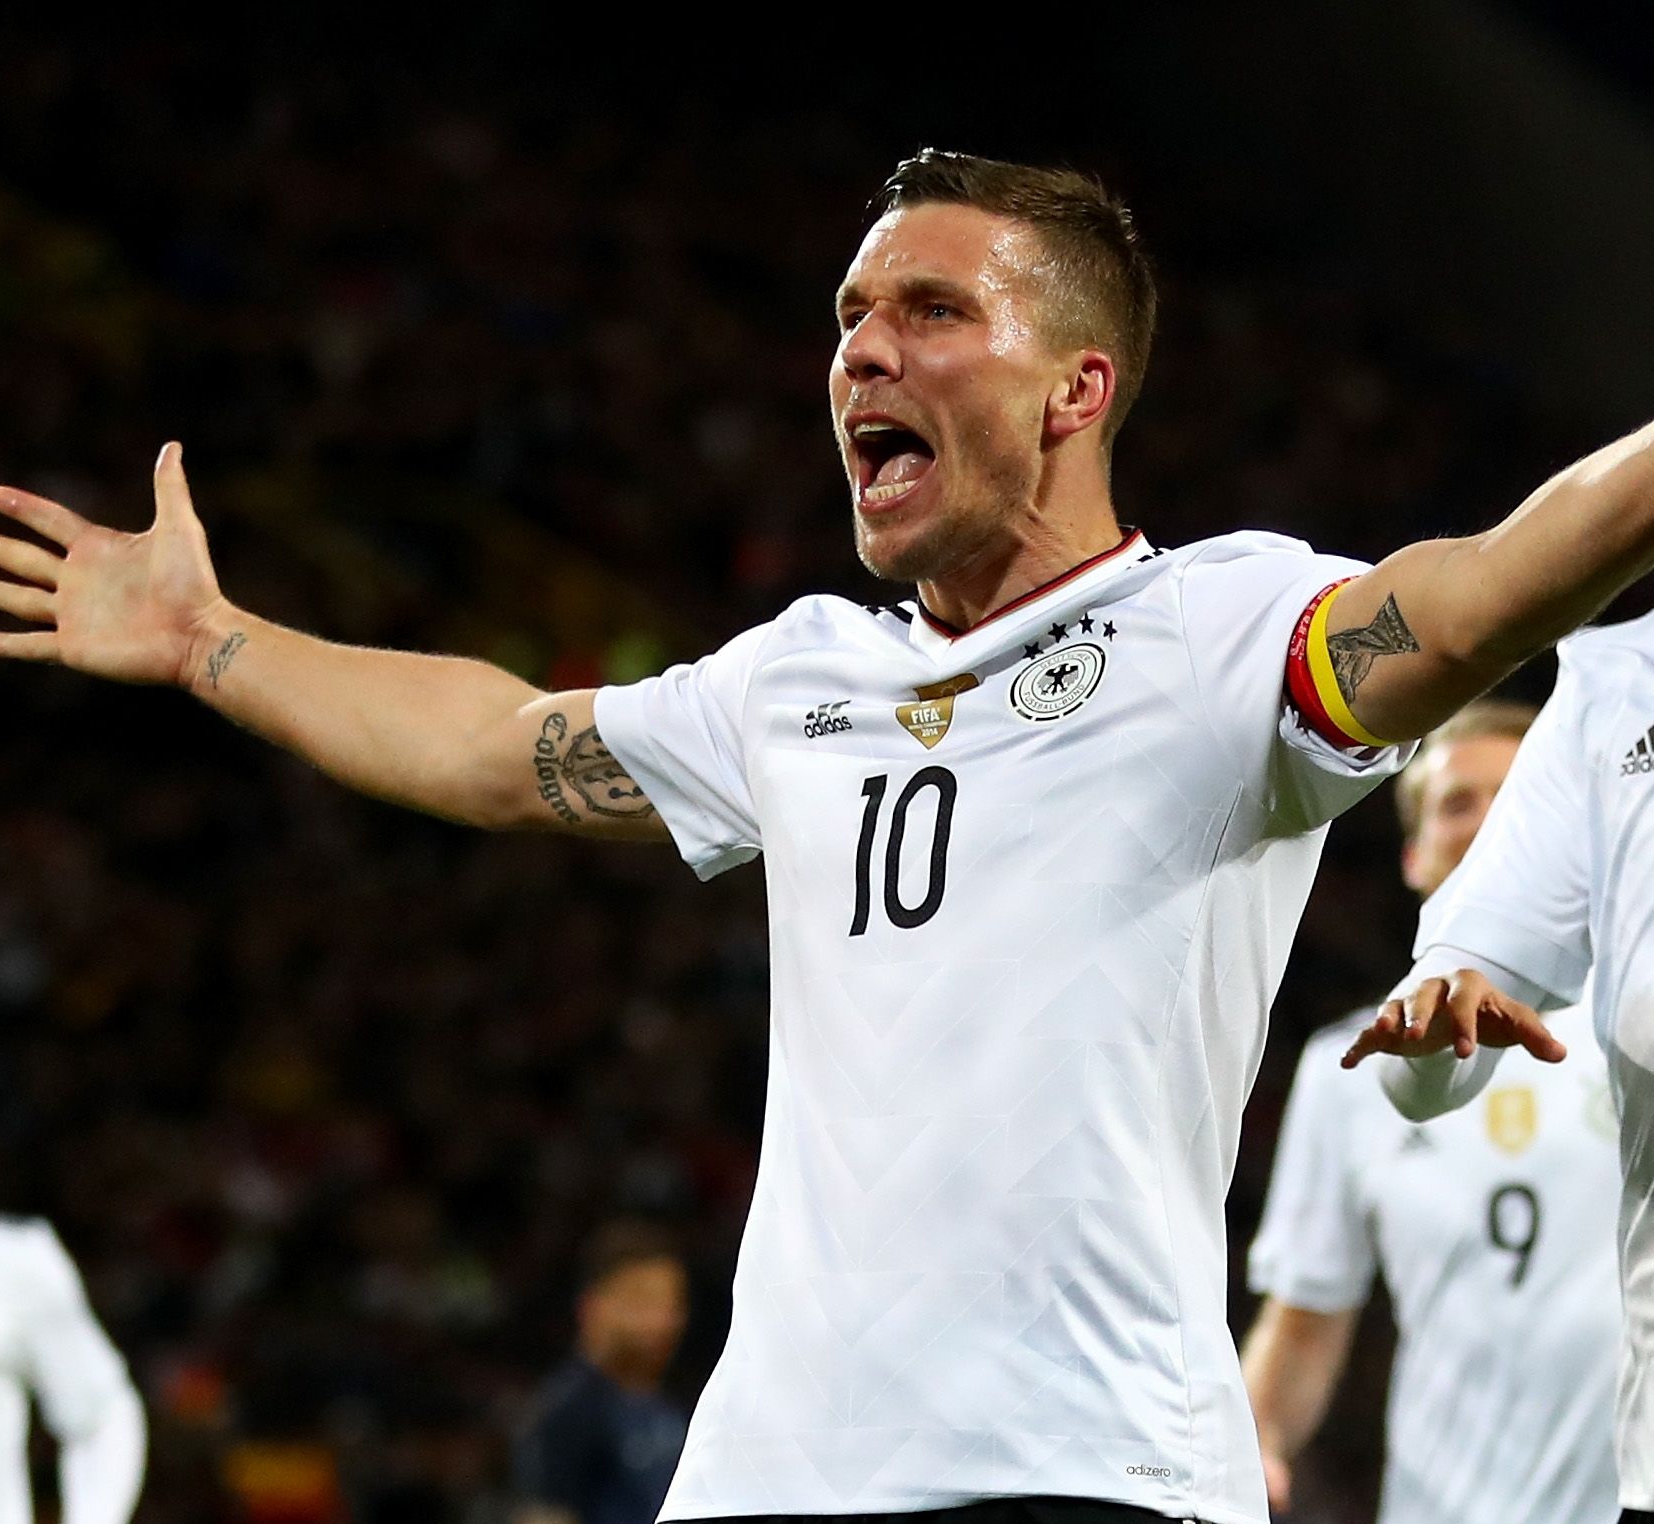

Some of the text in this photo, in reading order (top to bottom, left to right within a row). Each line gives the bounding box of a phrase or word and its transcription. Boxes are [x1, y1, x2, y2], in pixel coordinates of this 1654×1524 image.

[804, 713, 853, 739] adidas
[911, 707, 941, 724] FIFA
[848, 765, 958, 937] 10
[1489, 1182, 1540, 1291] 9
[1126, 1464, 1171, 1477] adizero
